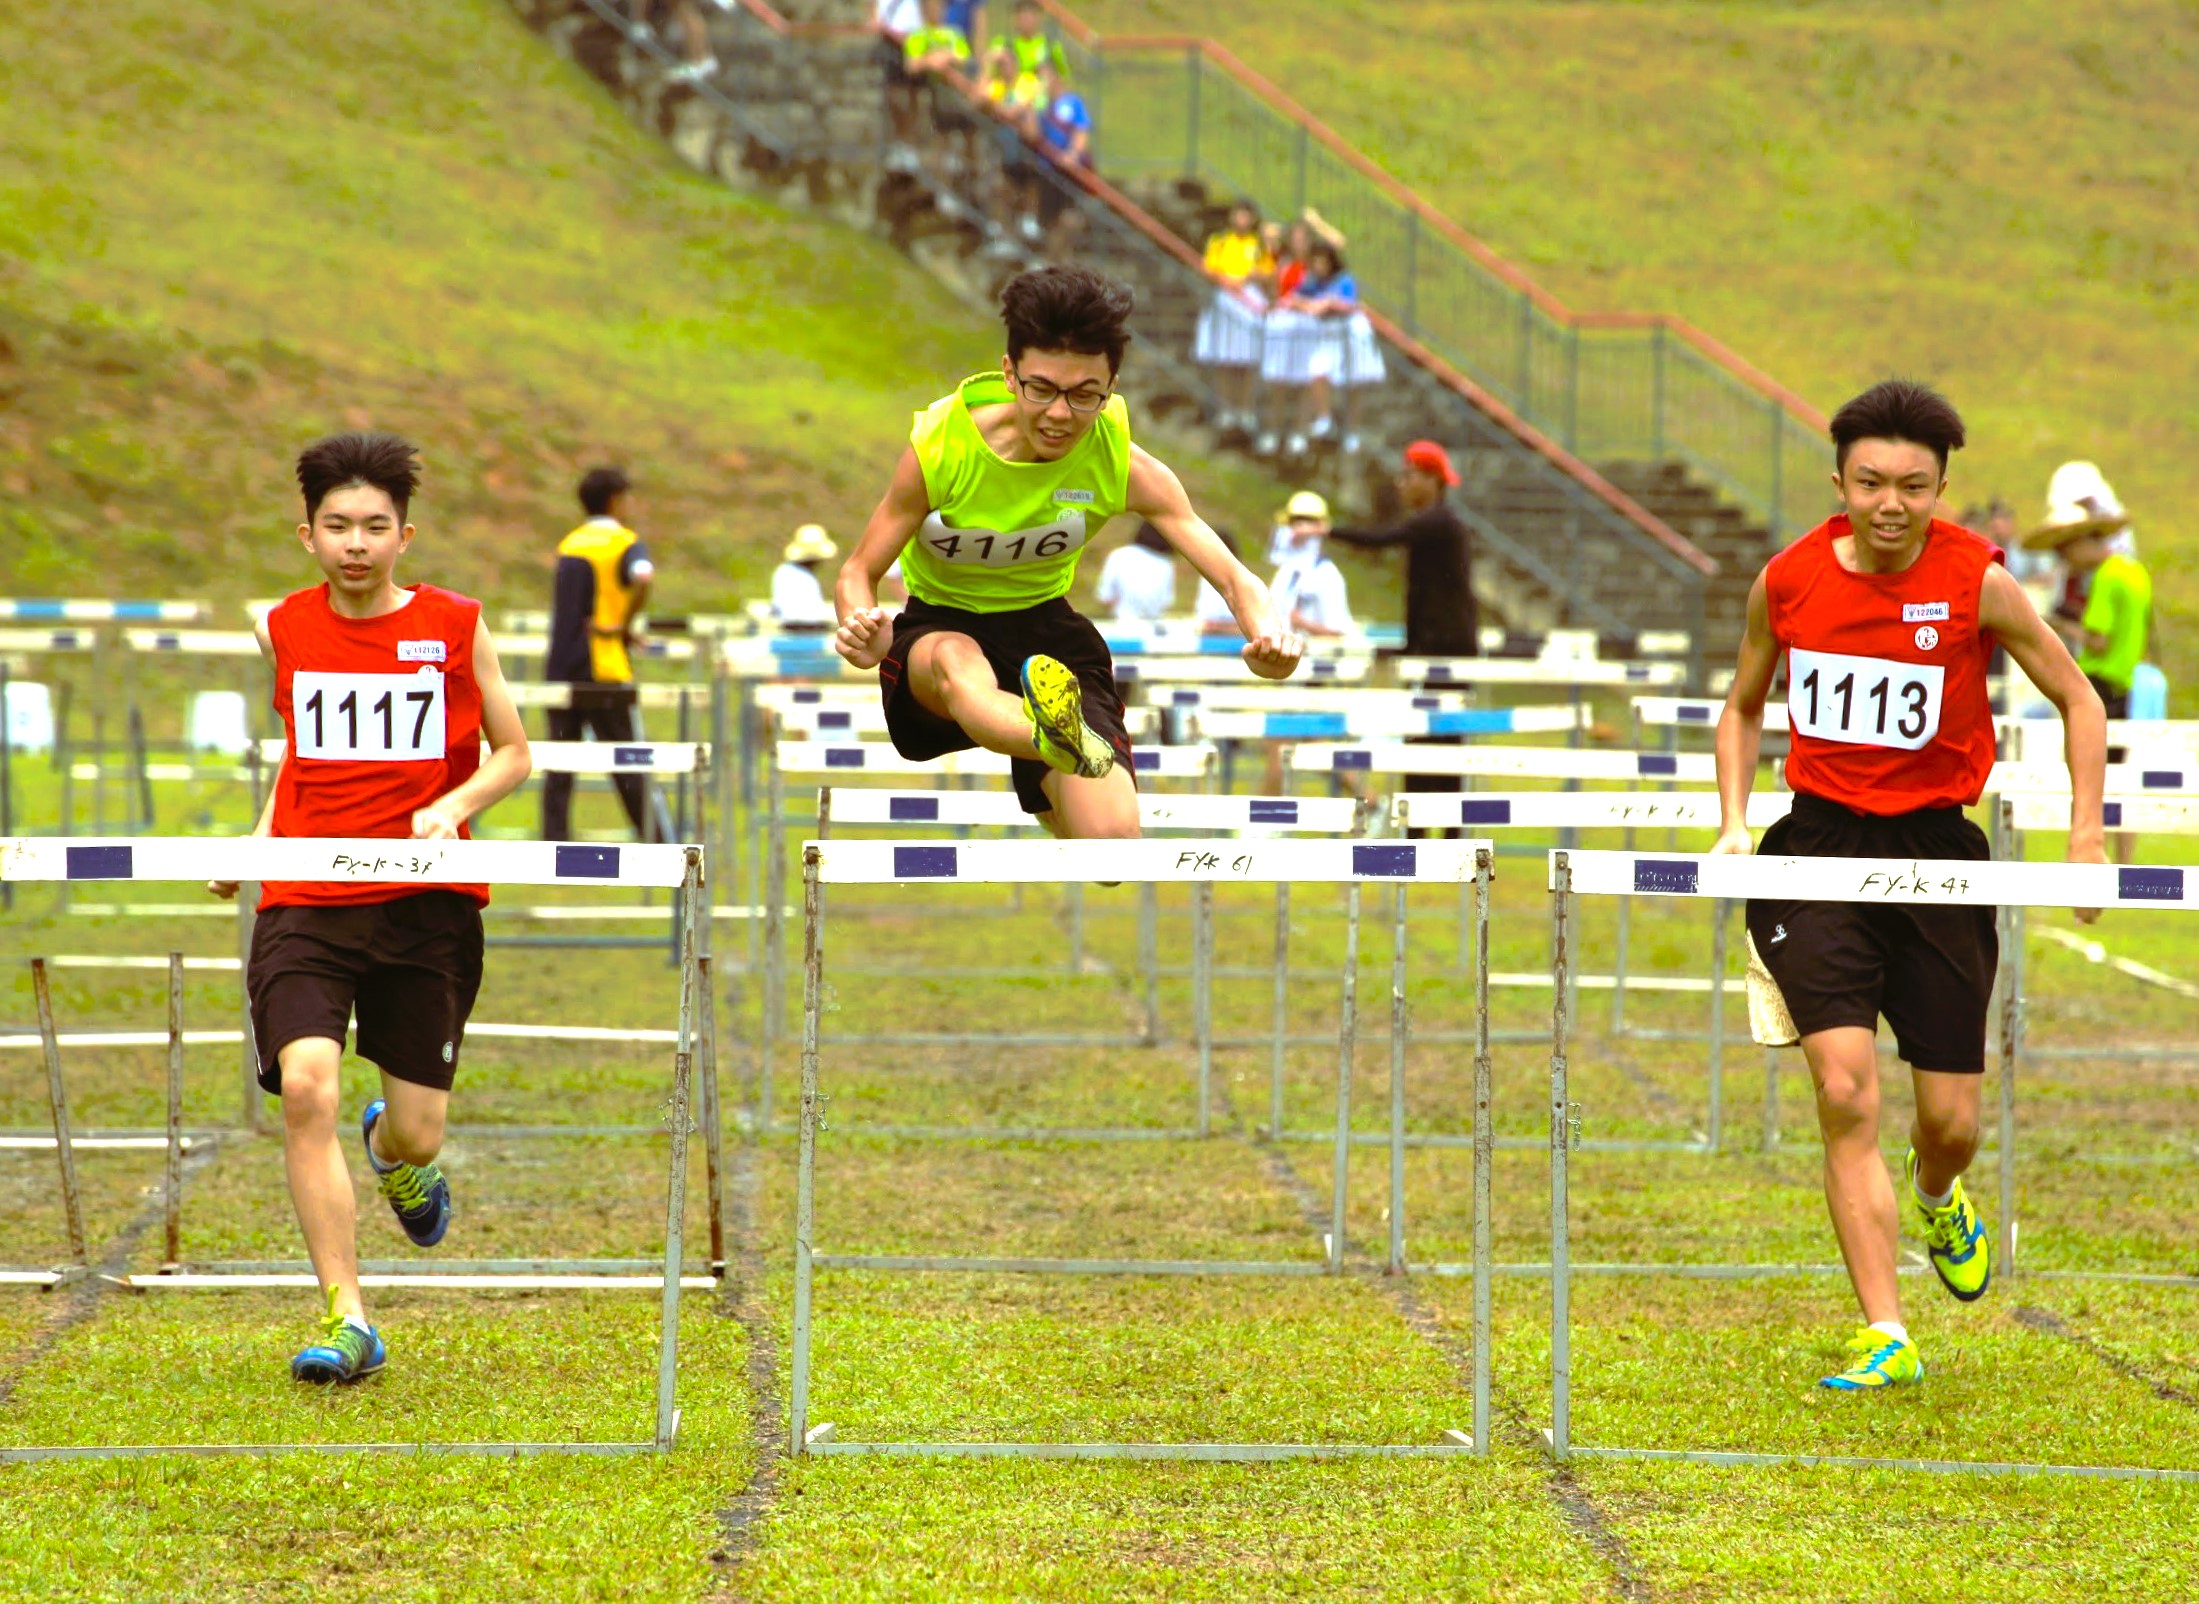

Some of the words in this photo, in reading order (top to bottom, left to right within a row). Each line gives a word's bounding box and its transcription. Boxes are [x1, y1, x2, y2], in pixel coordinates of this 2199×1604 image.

[929, 530, 1069, 561] 4116
[306, 689, 434, 750] 1117
[1803, 668, 1928, 740] 1113
[1232, 855, 1253, 875] 61
